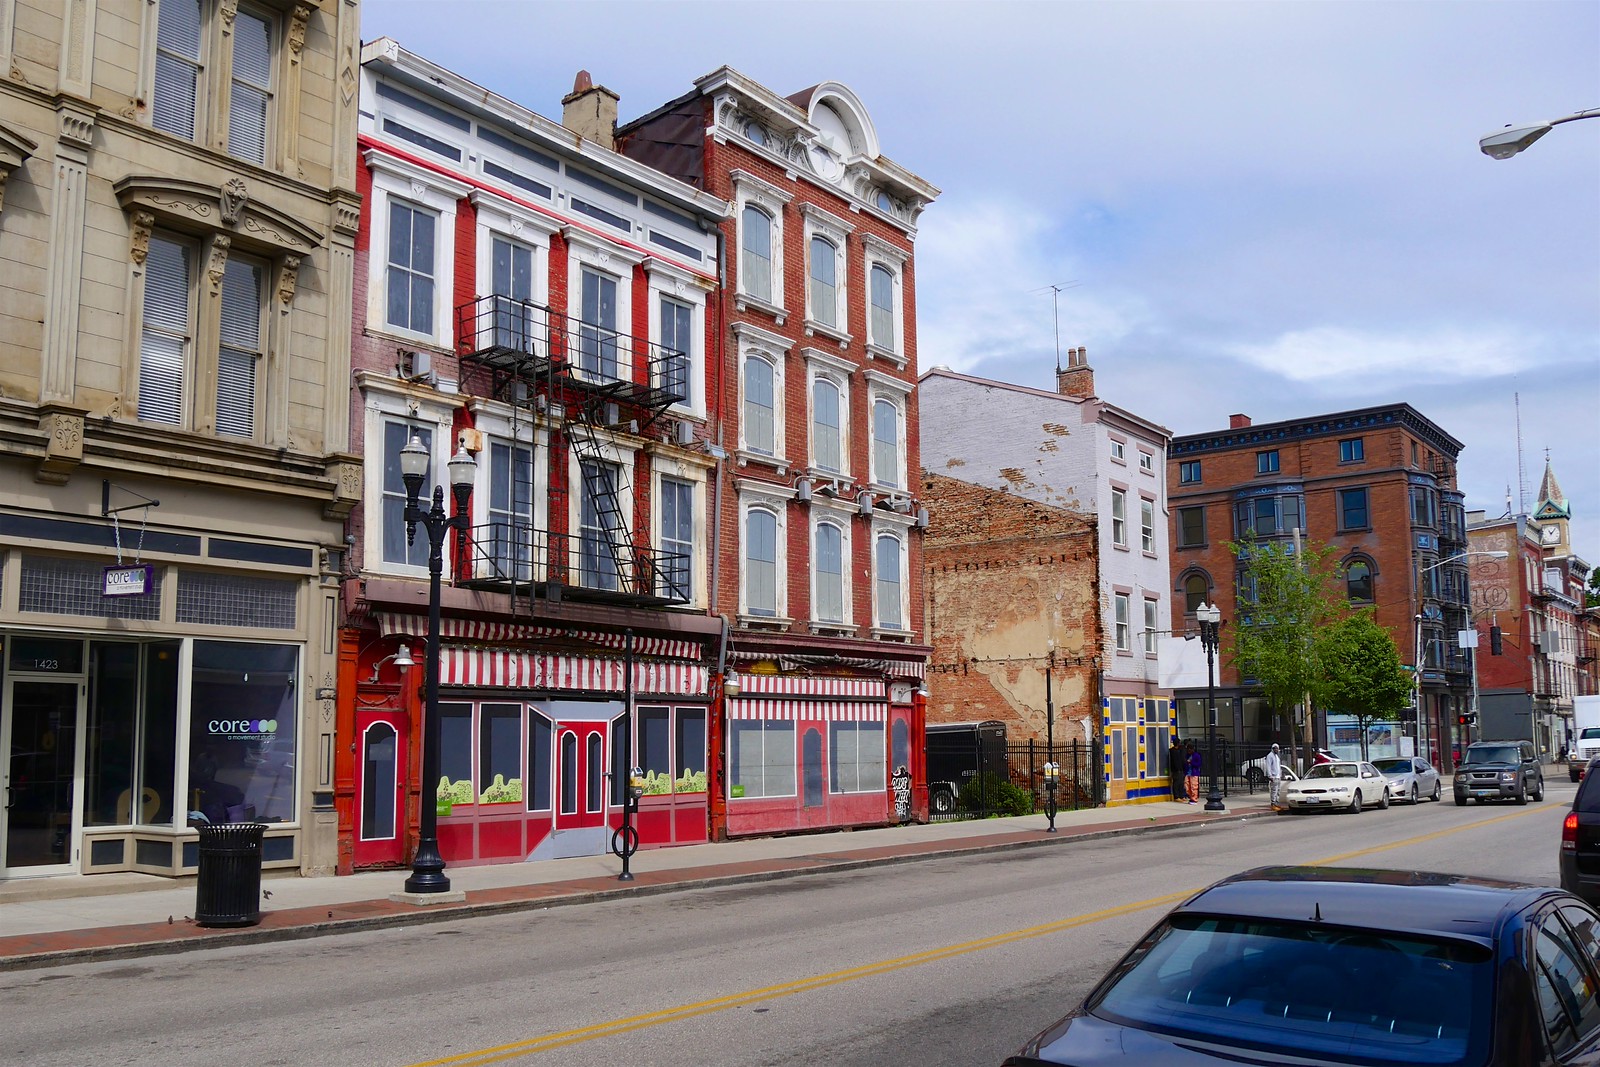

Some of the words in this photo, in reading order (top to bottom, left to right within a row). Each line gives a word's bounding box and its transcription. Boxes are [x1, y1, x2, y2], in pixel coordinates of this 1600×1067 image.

[107, 572, 130, 584] core
[34, 659, 58, 670] 1423
[208, 719, 250, 733] core
